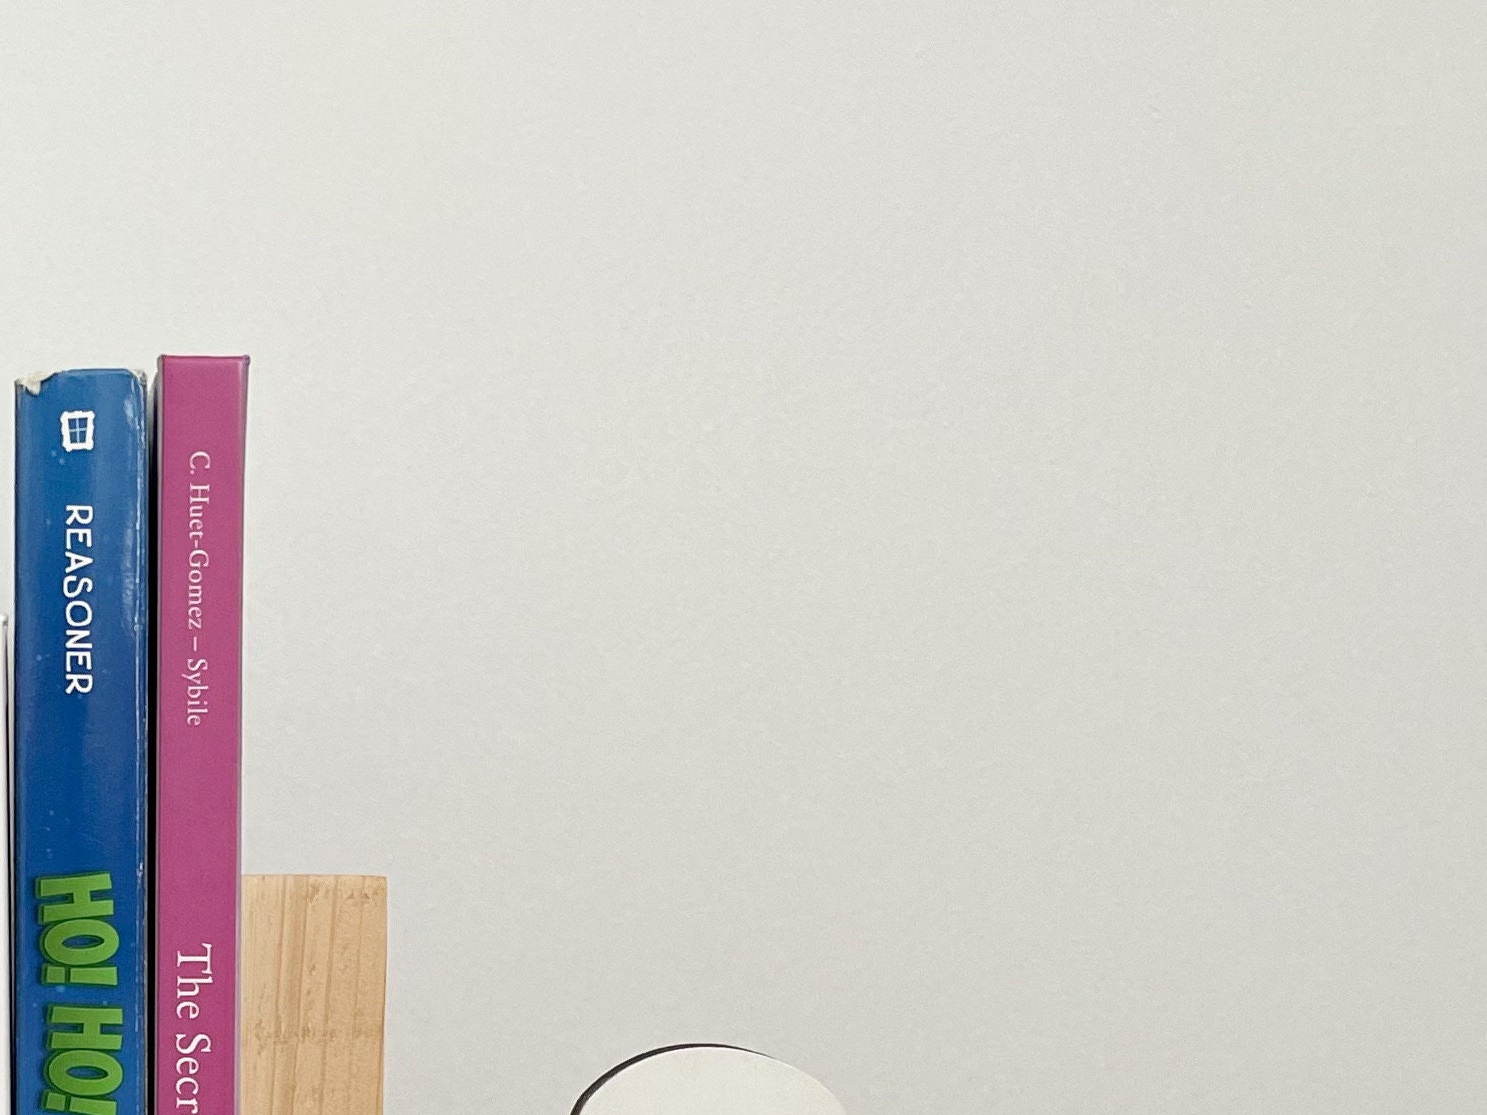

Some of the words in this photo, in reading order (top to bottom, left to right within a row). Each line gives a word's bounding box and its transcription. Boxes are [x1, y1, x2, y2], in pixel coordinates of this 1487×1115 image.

[189, 450, 211, 475] C.
[63, 504, 94, 694] REASONER
[188, 483, 211, 630] Huet-Gomez
[181, 658, 210, 726] Sybile
[36, 871, 120, 988] HO!
[176, 942, 214, 1019] The
